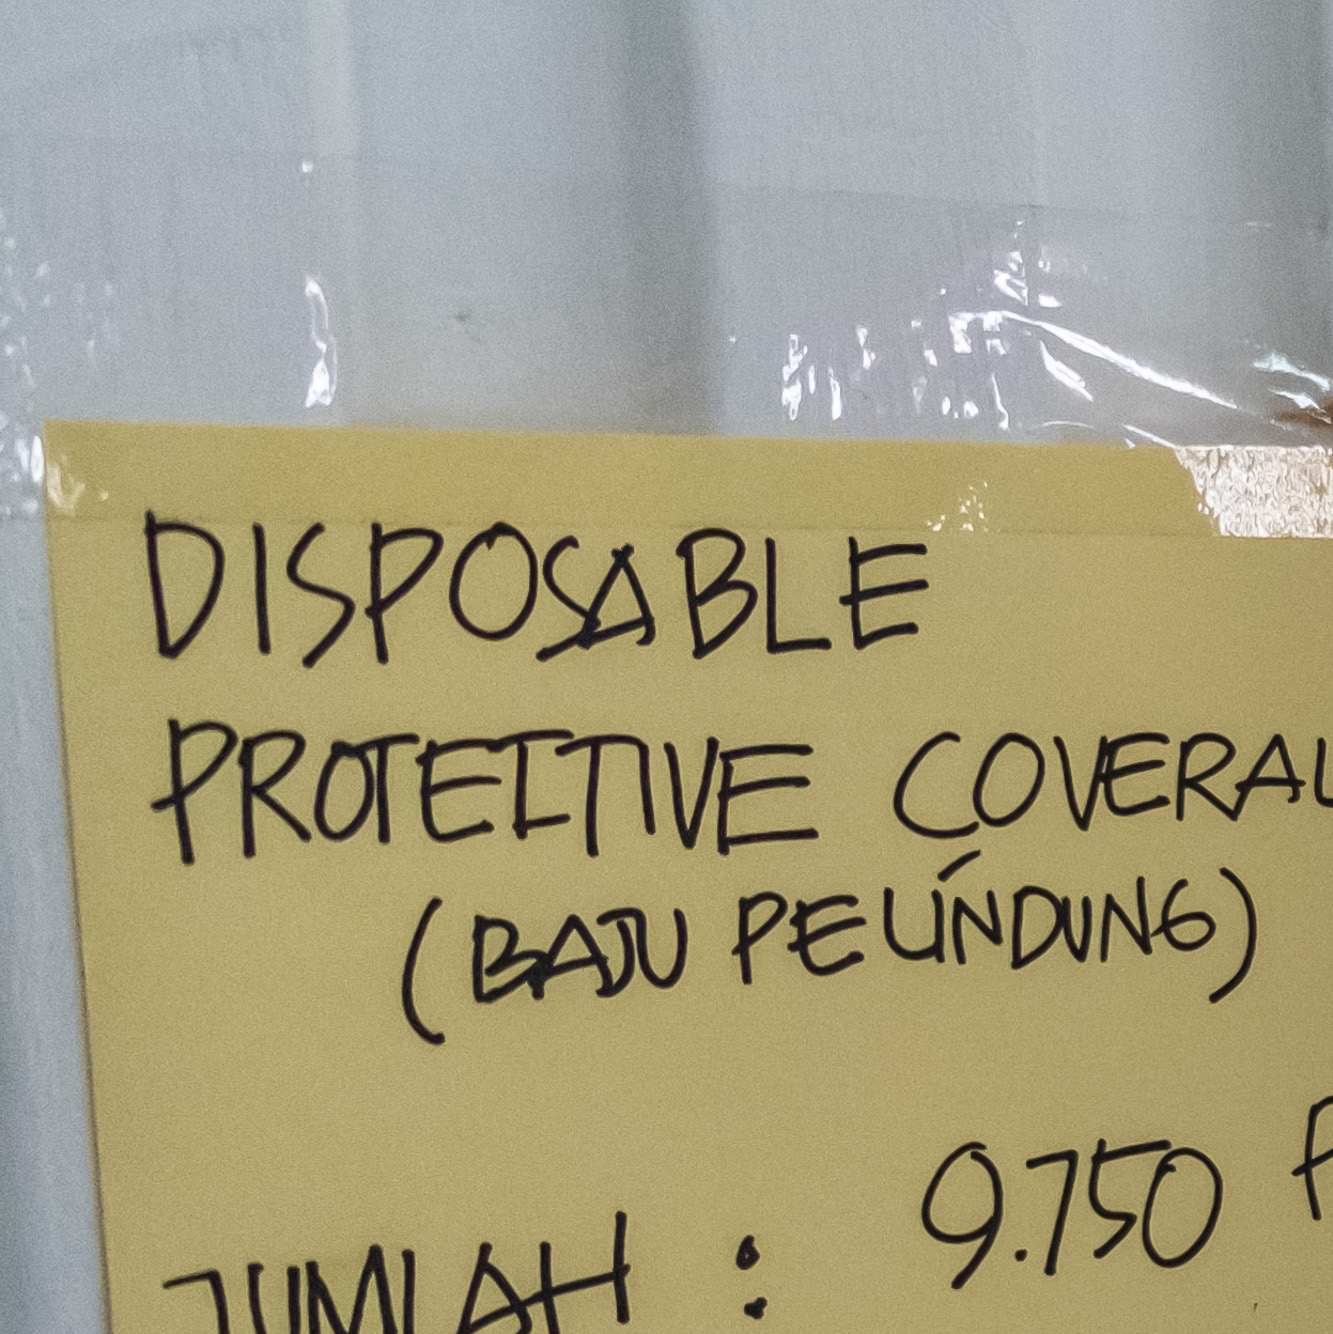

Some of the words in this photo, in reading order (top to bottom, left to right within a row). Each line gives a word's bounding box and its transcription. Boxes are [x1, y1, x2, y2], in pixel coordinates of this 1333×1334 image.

[142, 509, 930, 670] DISPOSABLE
[400, 896, 689, 1047] (BAJU
[919, 1136, 1224, 1291] 9.750
